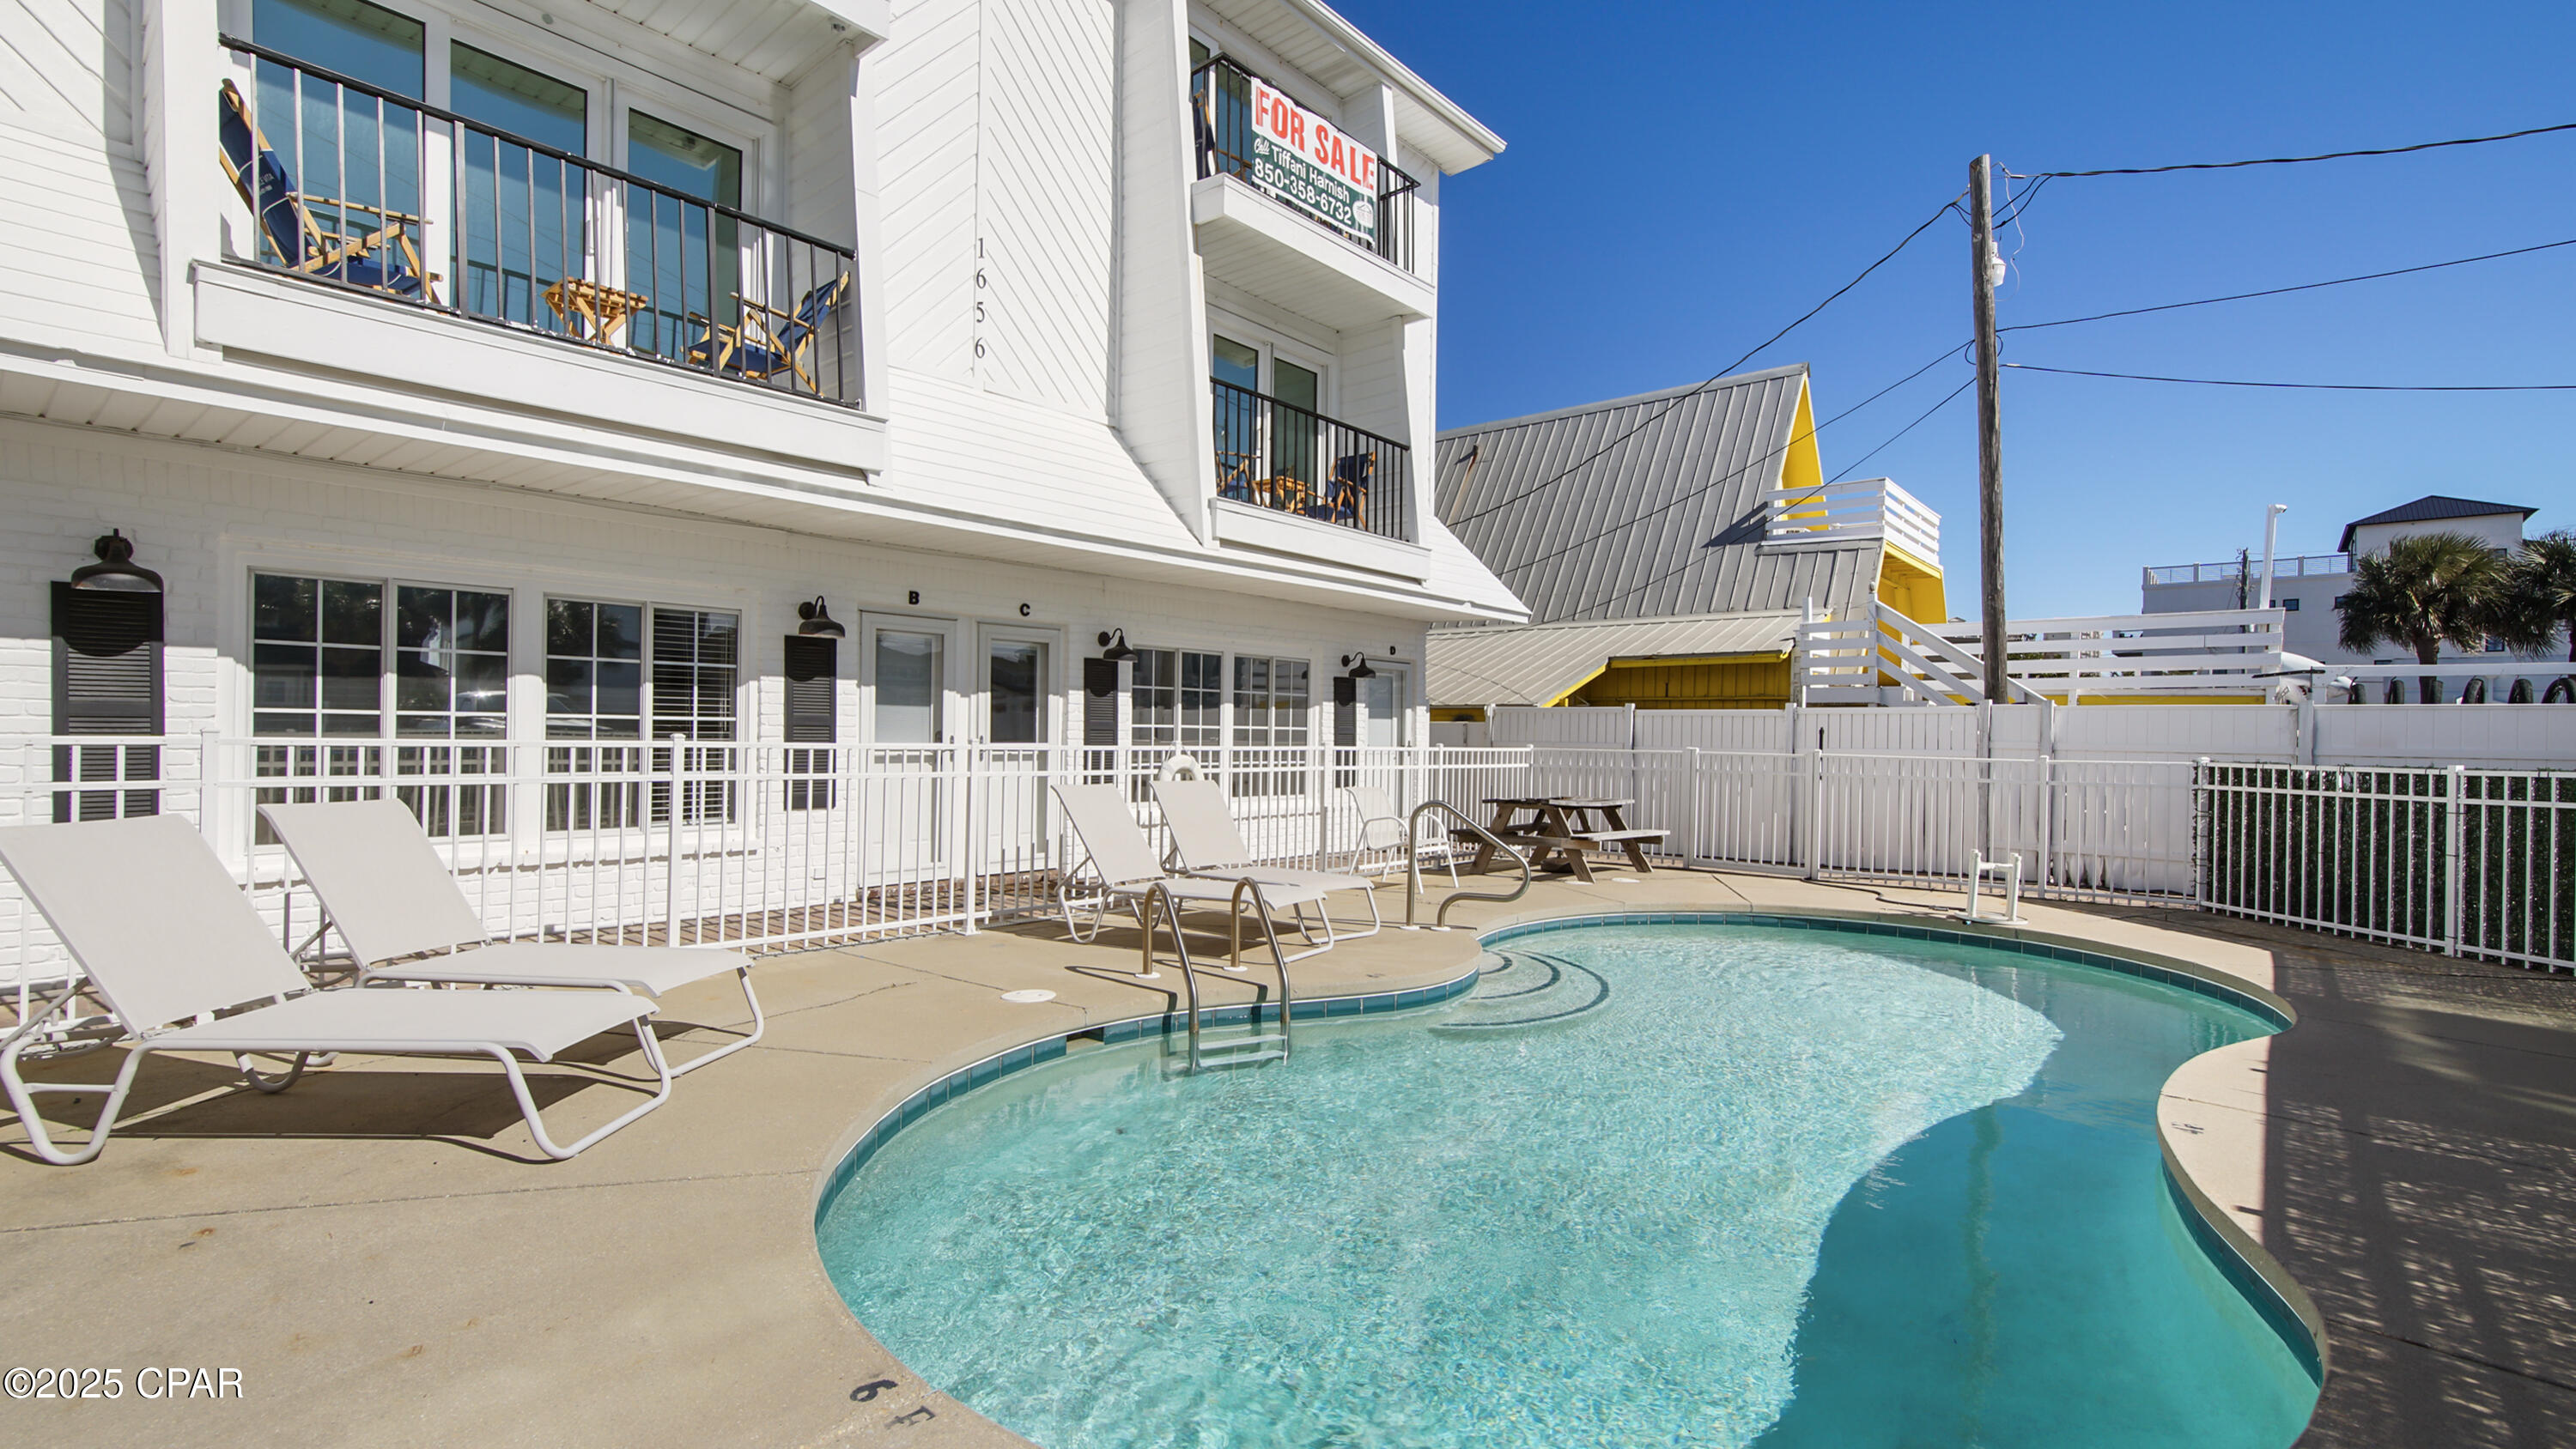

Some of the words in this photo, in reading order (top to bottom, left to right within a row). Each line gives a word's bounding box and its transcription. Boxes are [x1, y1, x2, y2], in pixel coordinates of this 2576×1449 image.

[1255, 86, 1305, 153] FOR
[1315, 124, 1375, 191] SALE
[1254, 137, 1271, 155] Call
[1272, 144, 1306, 179] Tiffani
[1309, 167, 1350, 204] Harnish
[1254, 158, 1352, 225] 850-358-6732
[975, 237, 987, 359] 1656
[908, 591, 920, 604] B
[1019, 603, 1030, 616] C
[1389, 646, 1396, 655] D
[850, 1379, 898, 1402] 6
